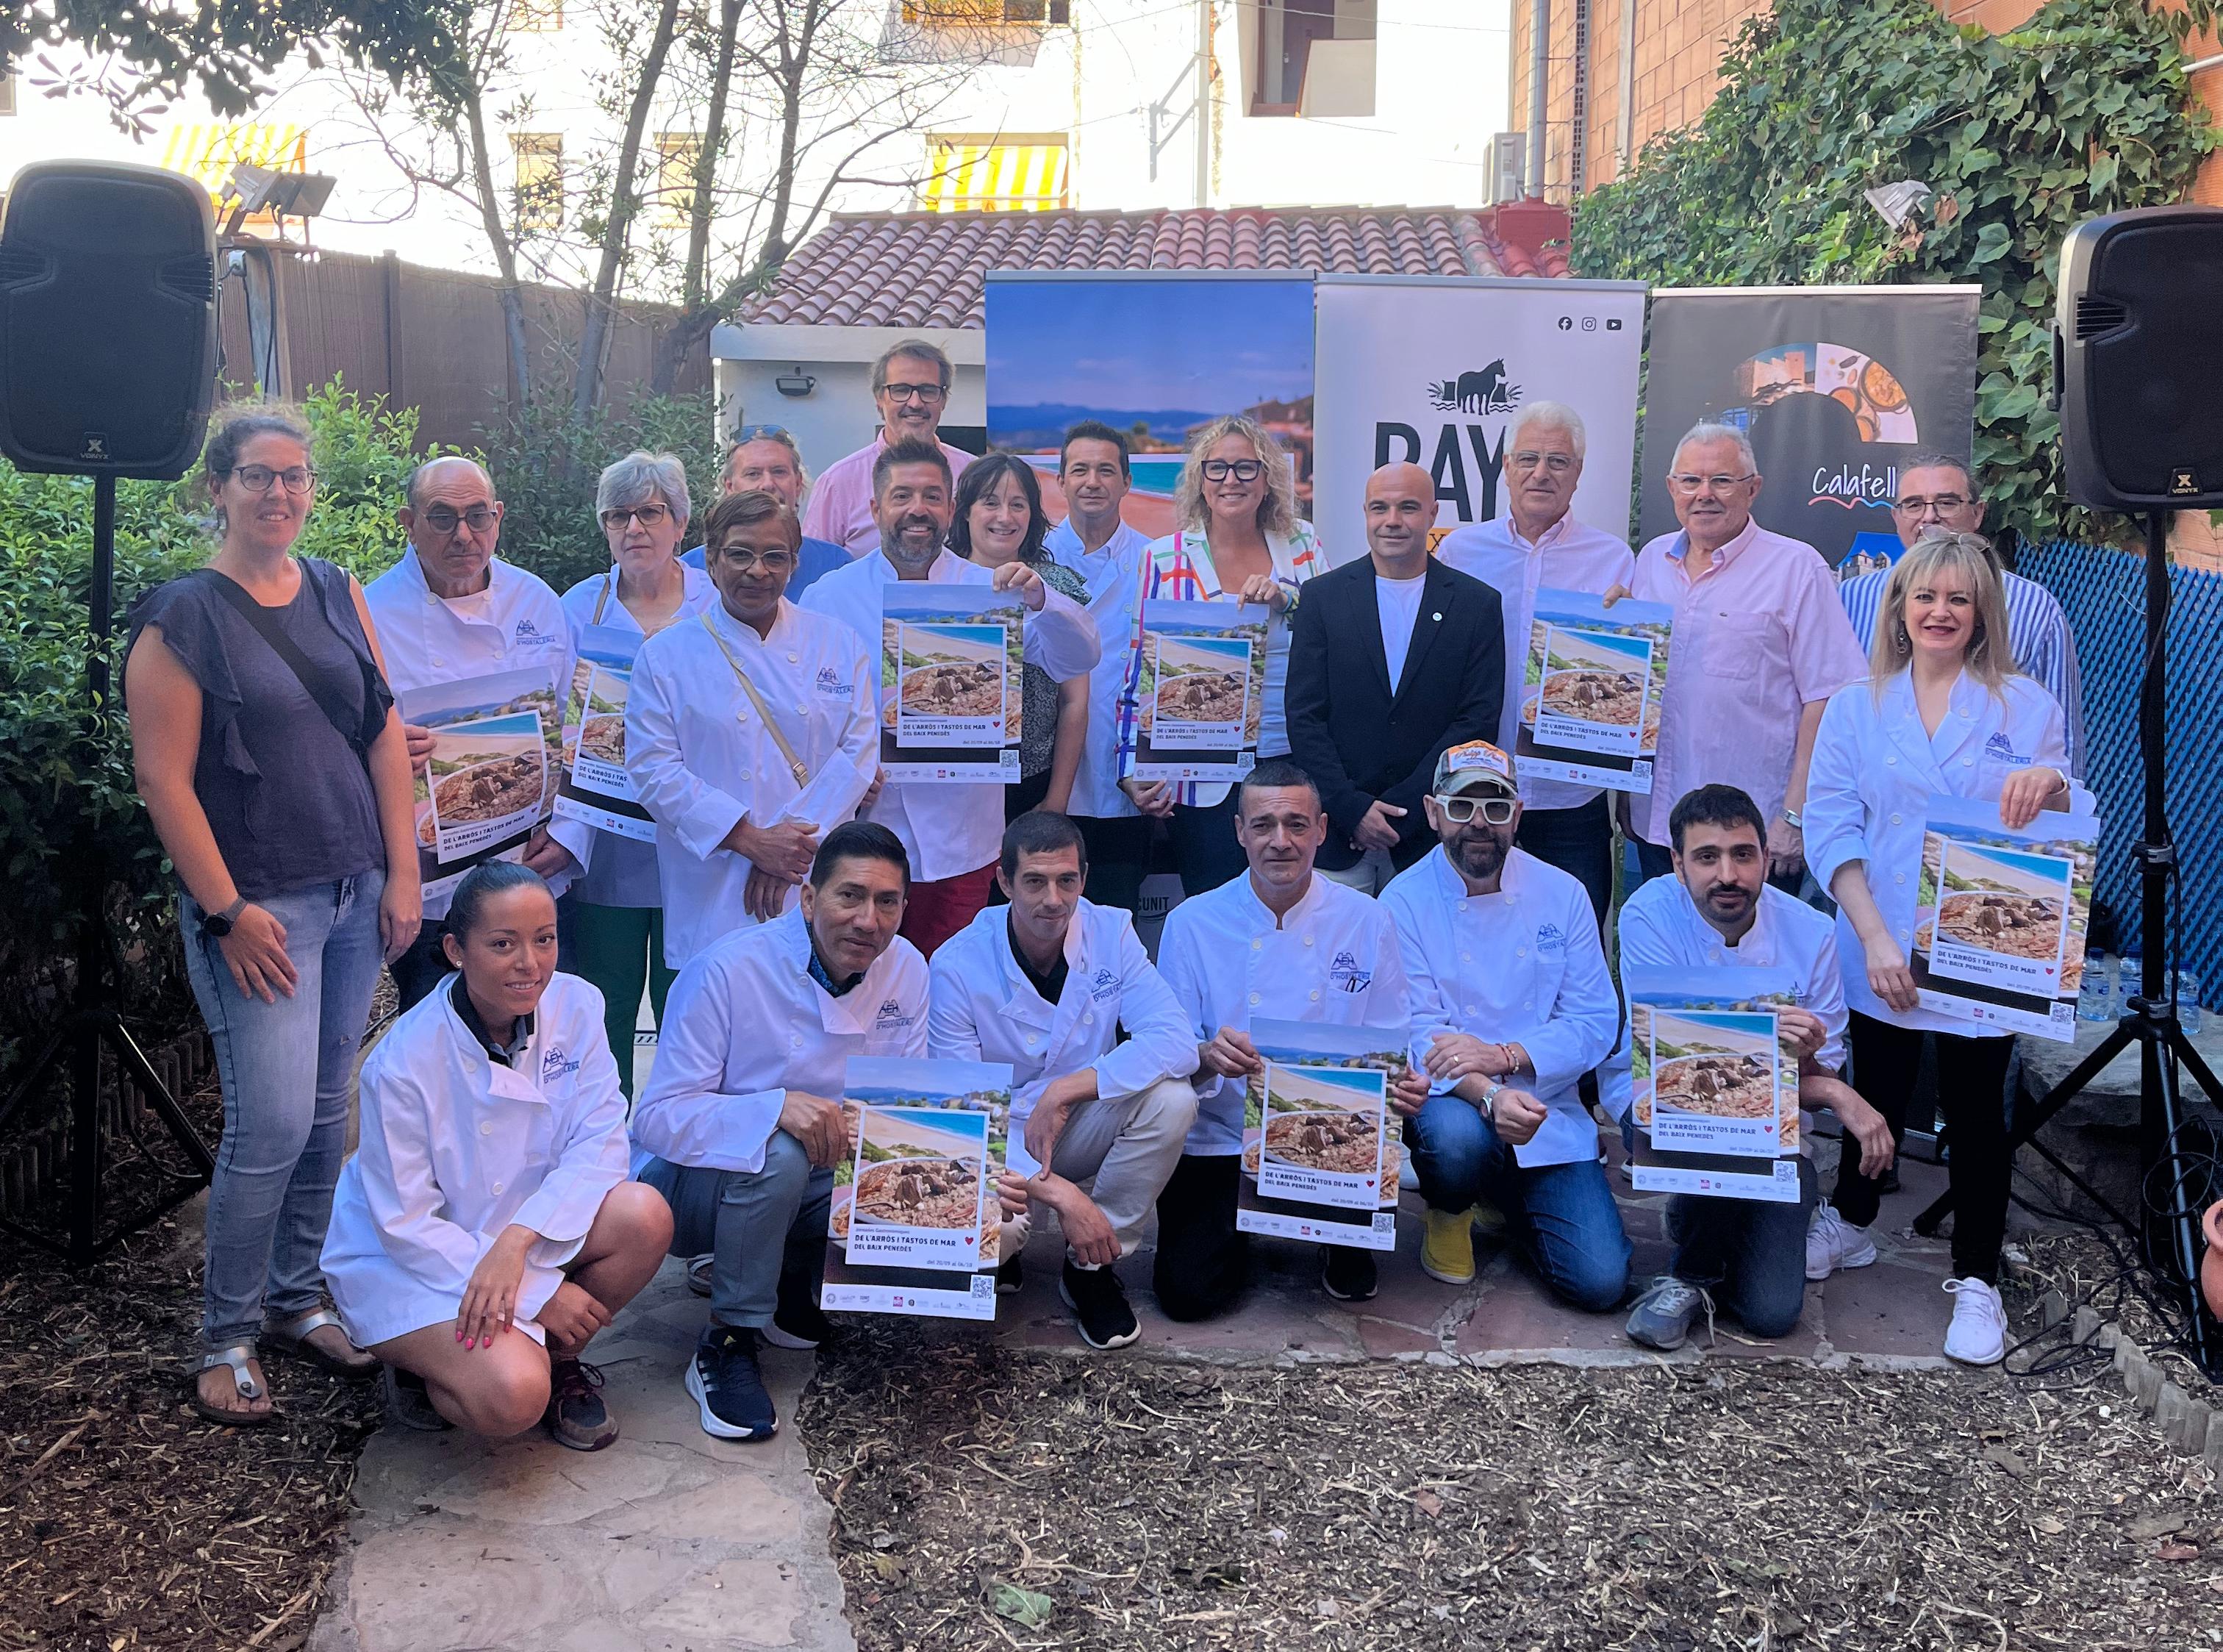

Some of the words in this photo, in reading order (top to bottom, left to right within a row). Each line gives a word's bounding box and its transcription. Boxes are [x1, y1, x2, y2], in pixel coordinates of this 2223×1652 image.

[1812, 463, 1897, 498] Calafell
[1307, 1177, 1332, 1186] TASTOS
[901, 1237, 928, 1245] TASTOS
